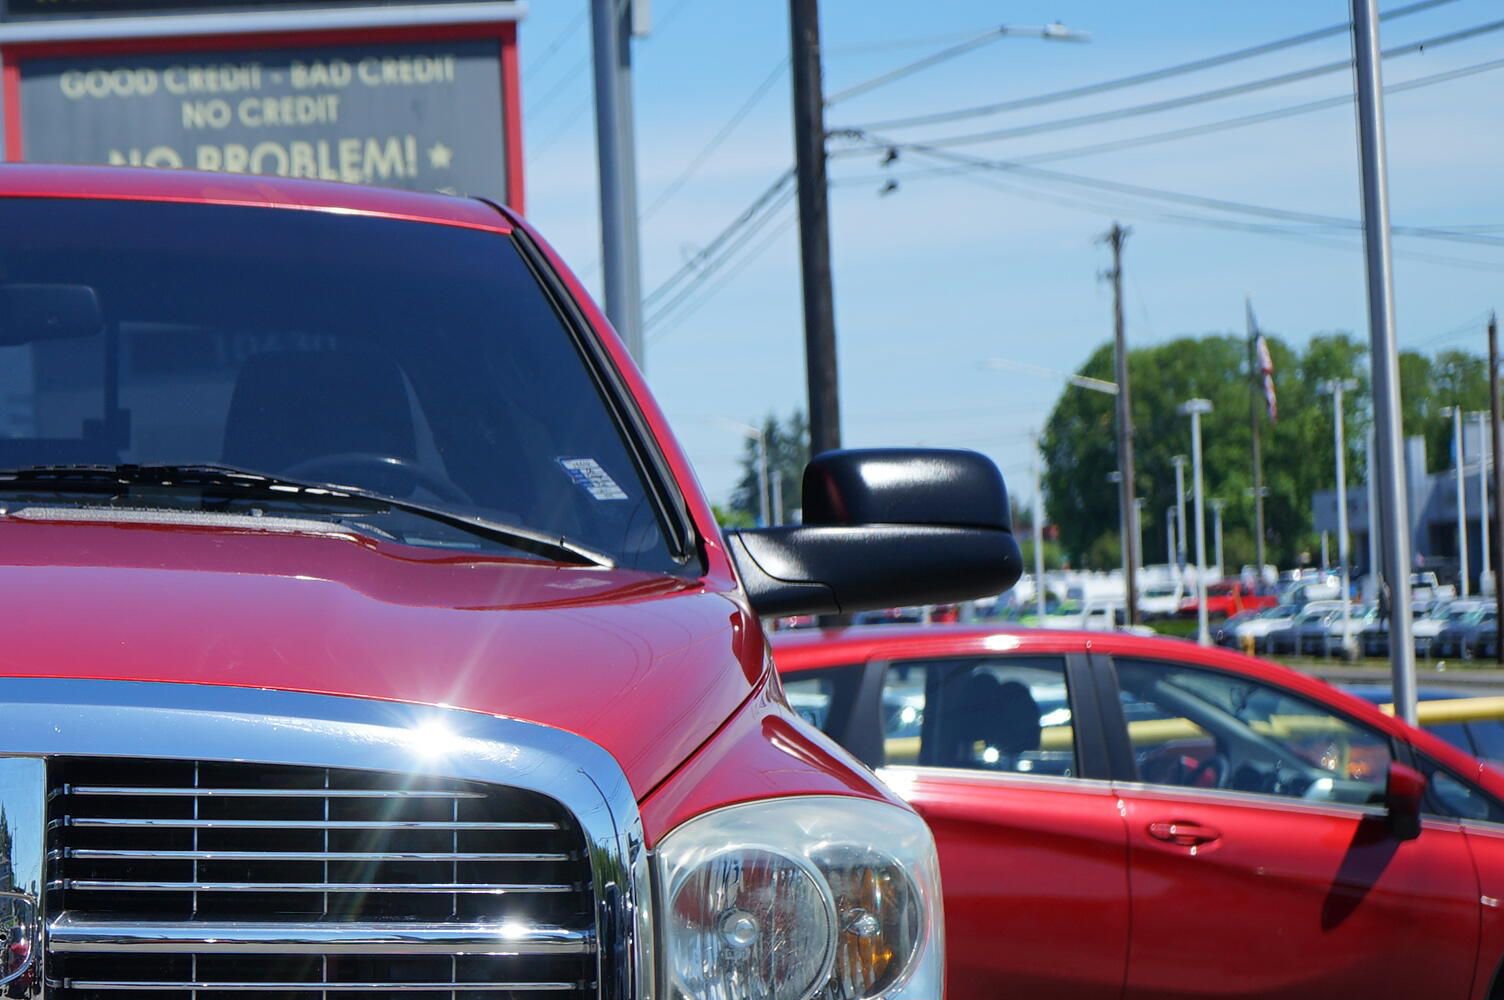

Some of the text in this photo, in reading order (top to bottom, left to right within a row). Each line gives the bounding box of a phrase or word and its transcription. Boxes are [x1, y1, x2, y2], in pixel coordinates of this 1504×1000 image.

[60, 68, 158, 98] GOOD
[163, 63, 262, 95] CREDIT
[291, 59, 352, 89] BAD
[357, 54, 455, 86] CREDIT
[182, 95, 340, 129] NO CREDIT
